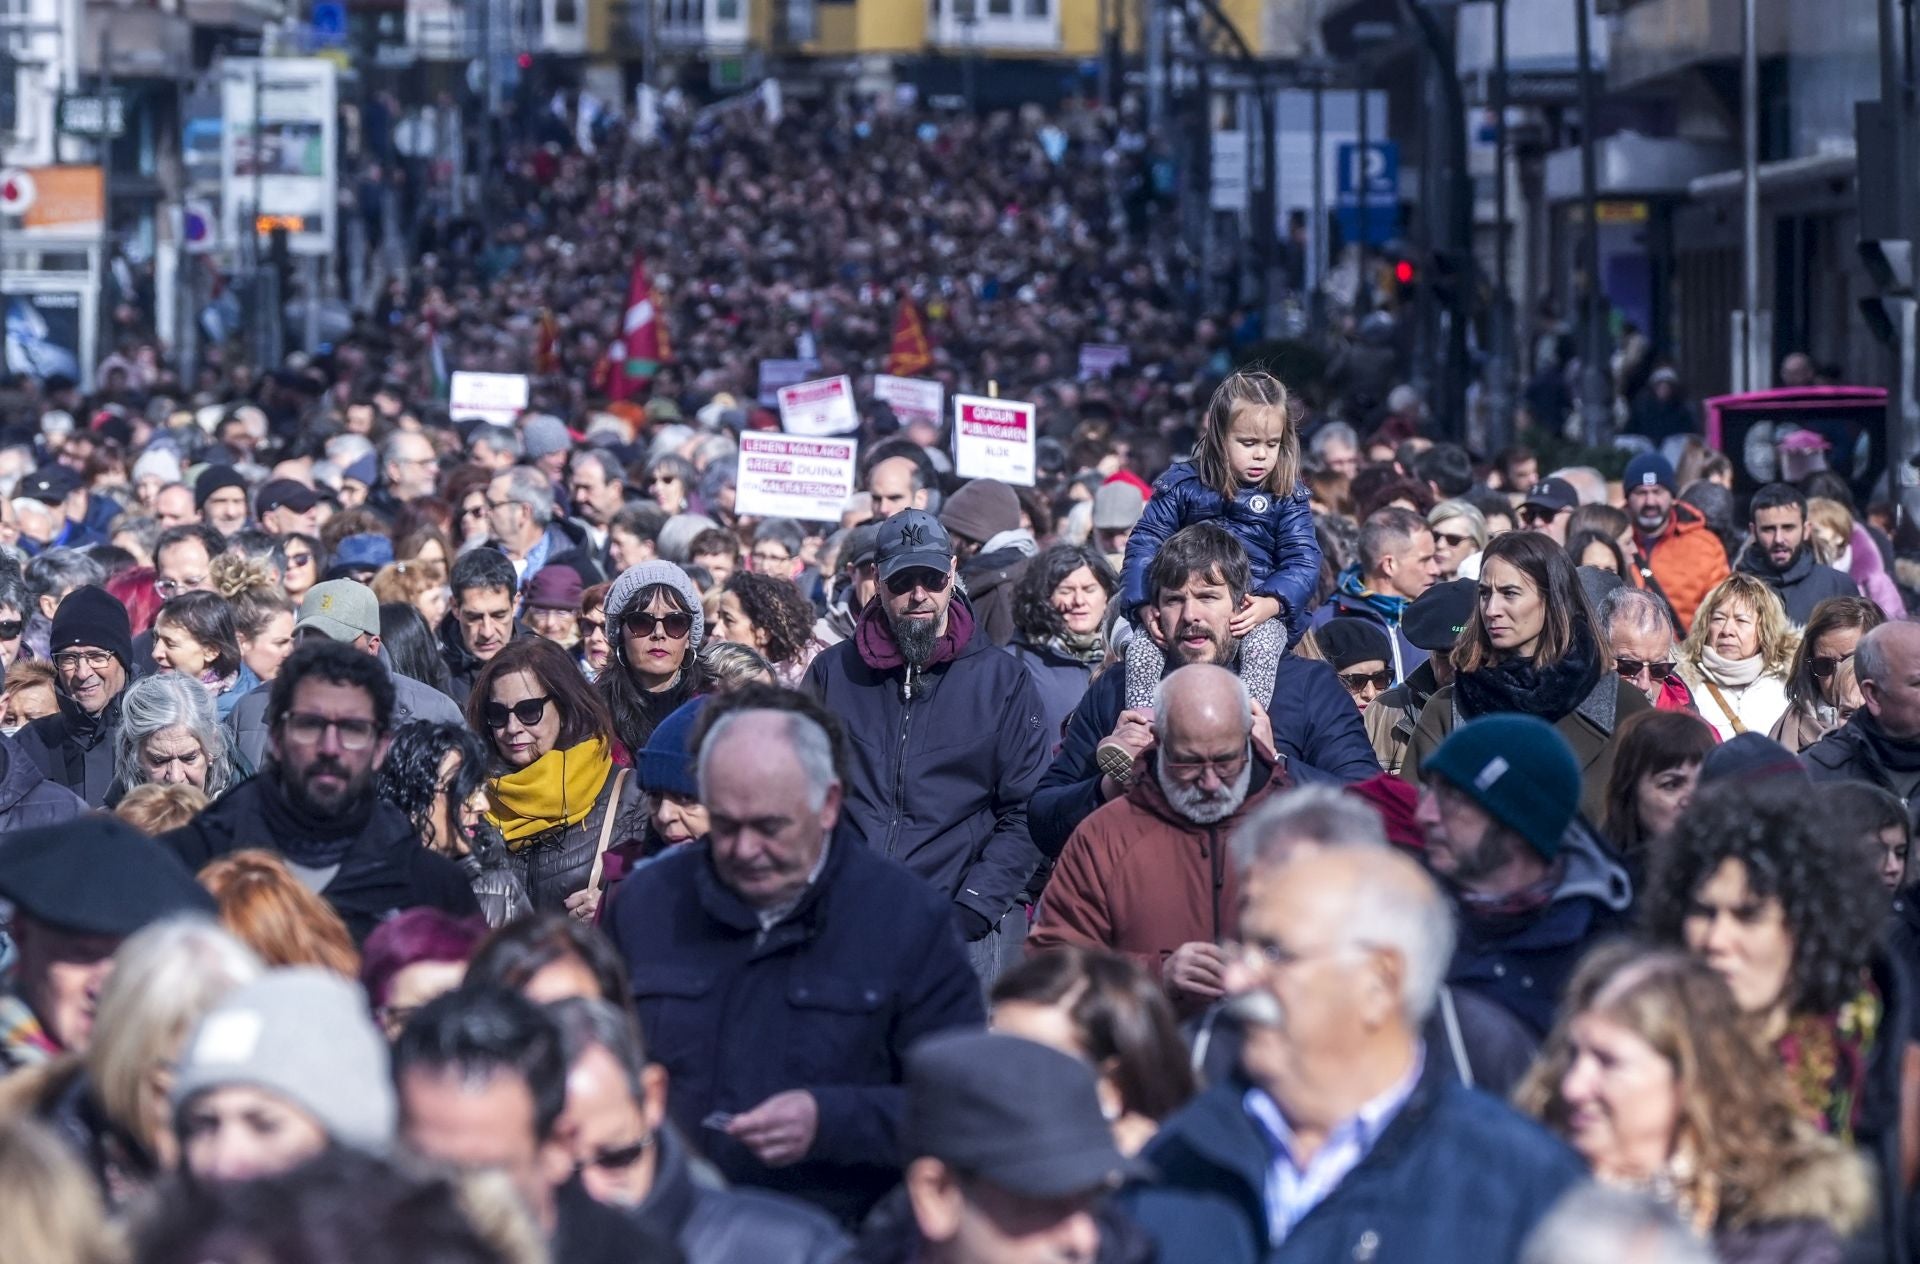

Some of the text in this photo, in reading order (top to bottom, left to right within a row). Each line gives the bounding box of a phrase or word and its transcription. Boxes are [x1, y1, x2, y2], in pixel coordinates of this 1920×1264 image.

[746, 440, 785, 454] LEHEN
[797, 464, 843, 477] DUINA
[901, 524, 923, 546] NY
